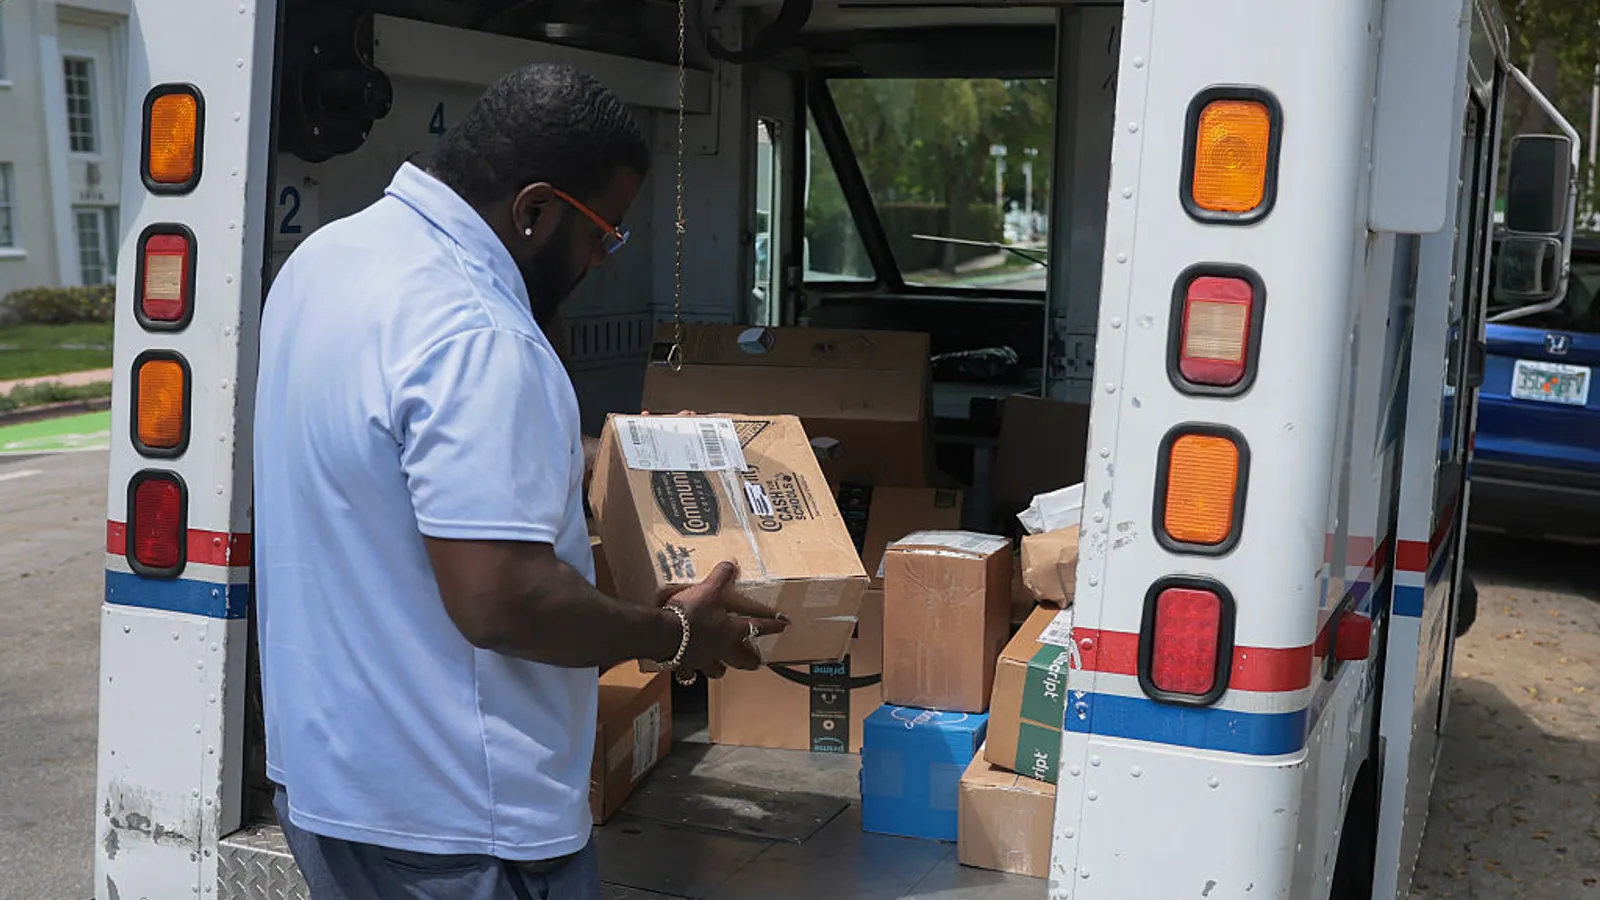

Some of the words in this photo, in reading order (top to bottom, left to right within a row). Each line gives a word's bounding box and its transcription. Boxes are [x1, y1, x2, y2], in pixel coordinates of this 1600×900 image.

[428, 101, 447, 136] 4
[279, 185, 302, 234] 2
[666, 471, 711, 532] Communi
[768, 491, 793, 522] CASH
[783, 483, 807, 520] SCHOOLS
[813, 663, 845, 676] prime
[1032, 751, 1049, 780] ript
